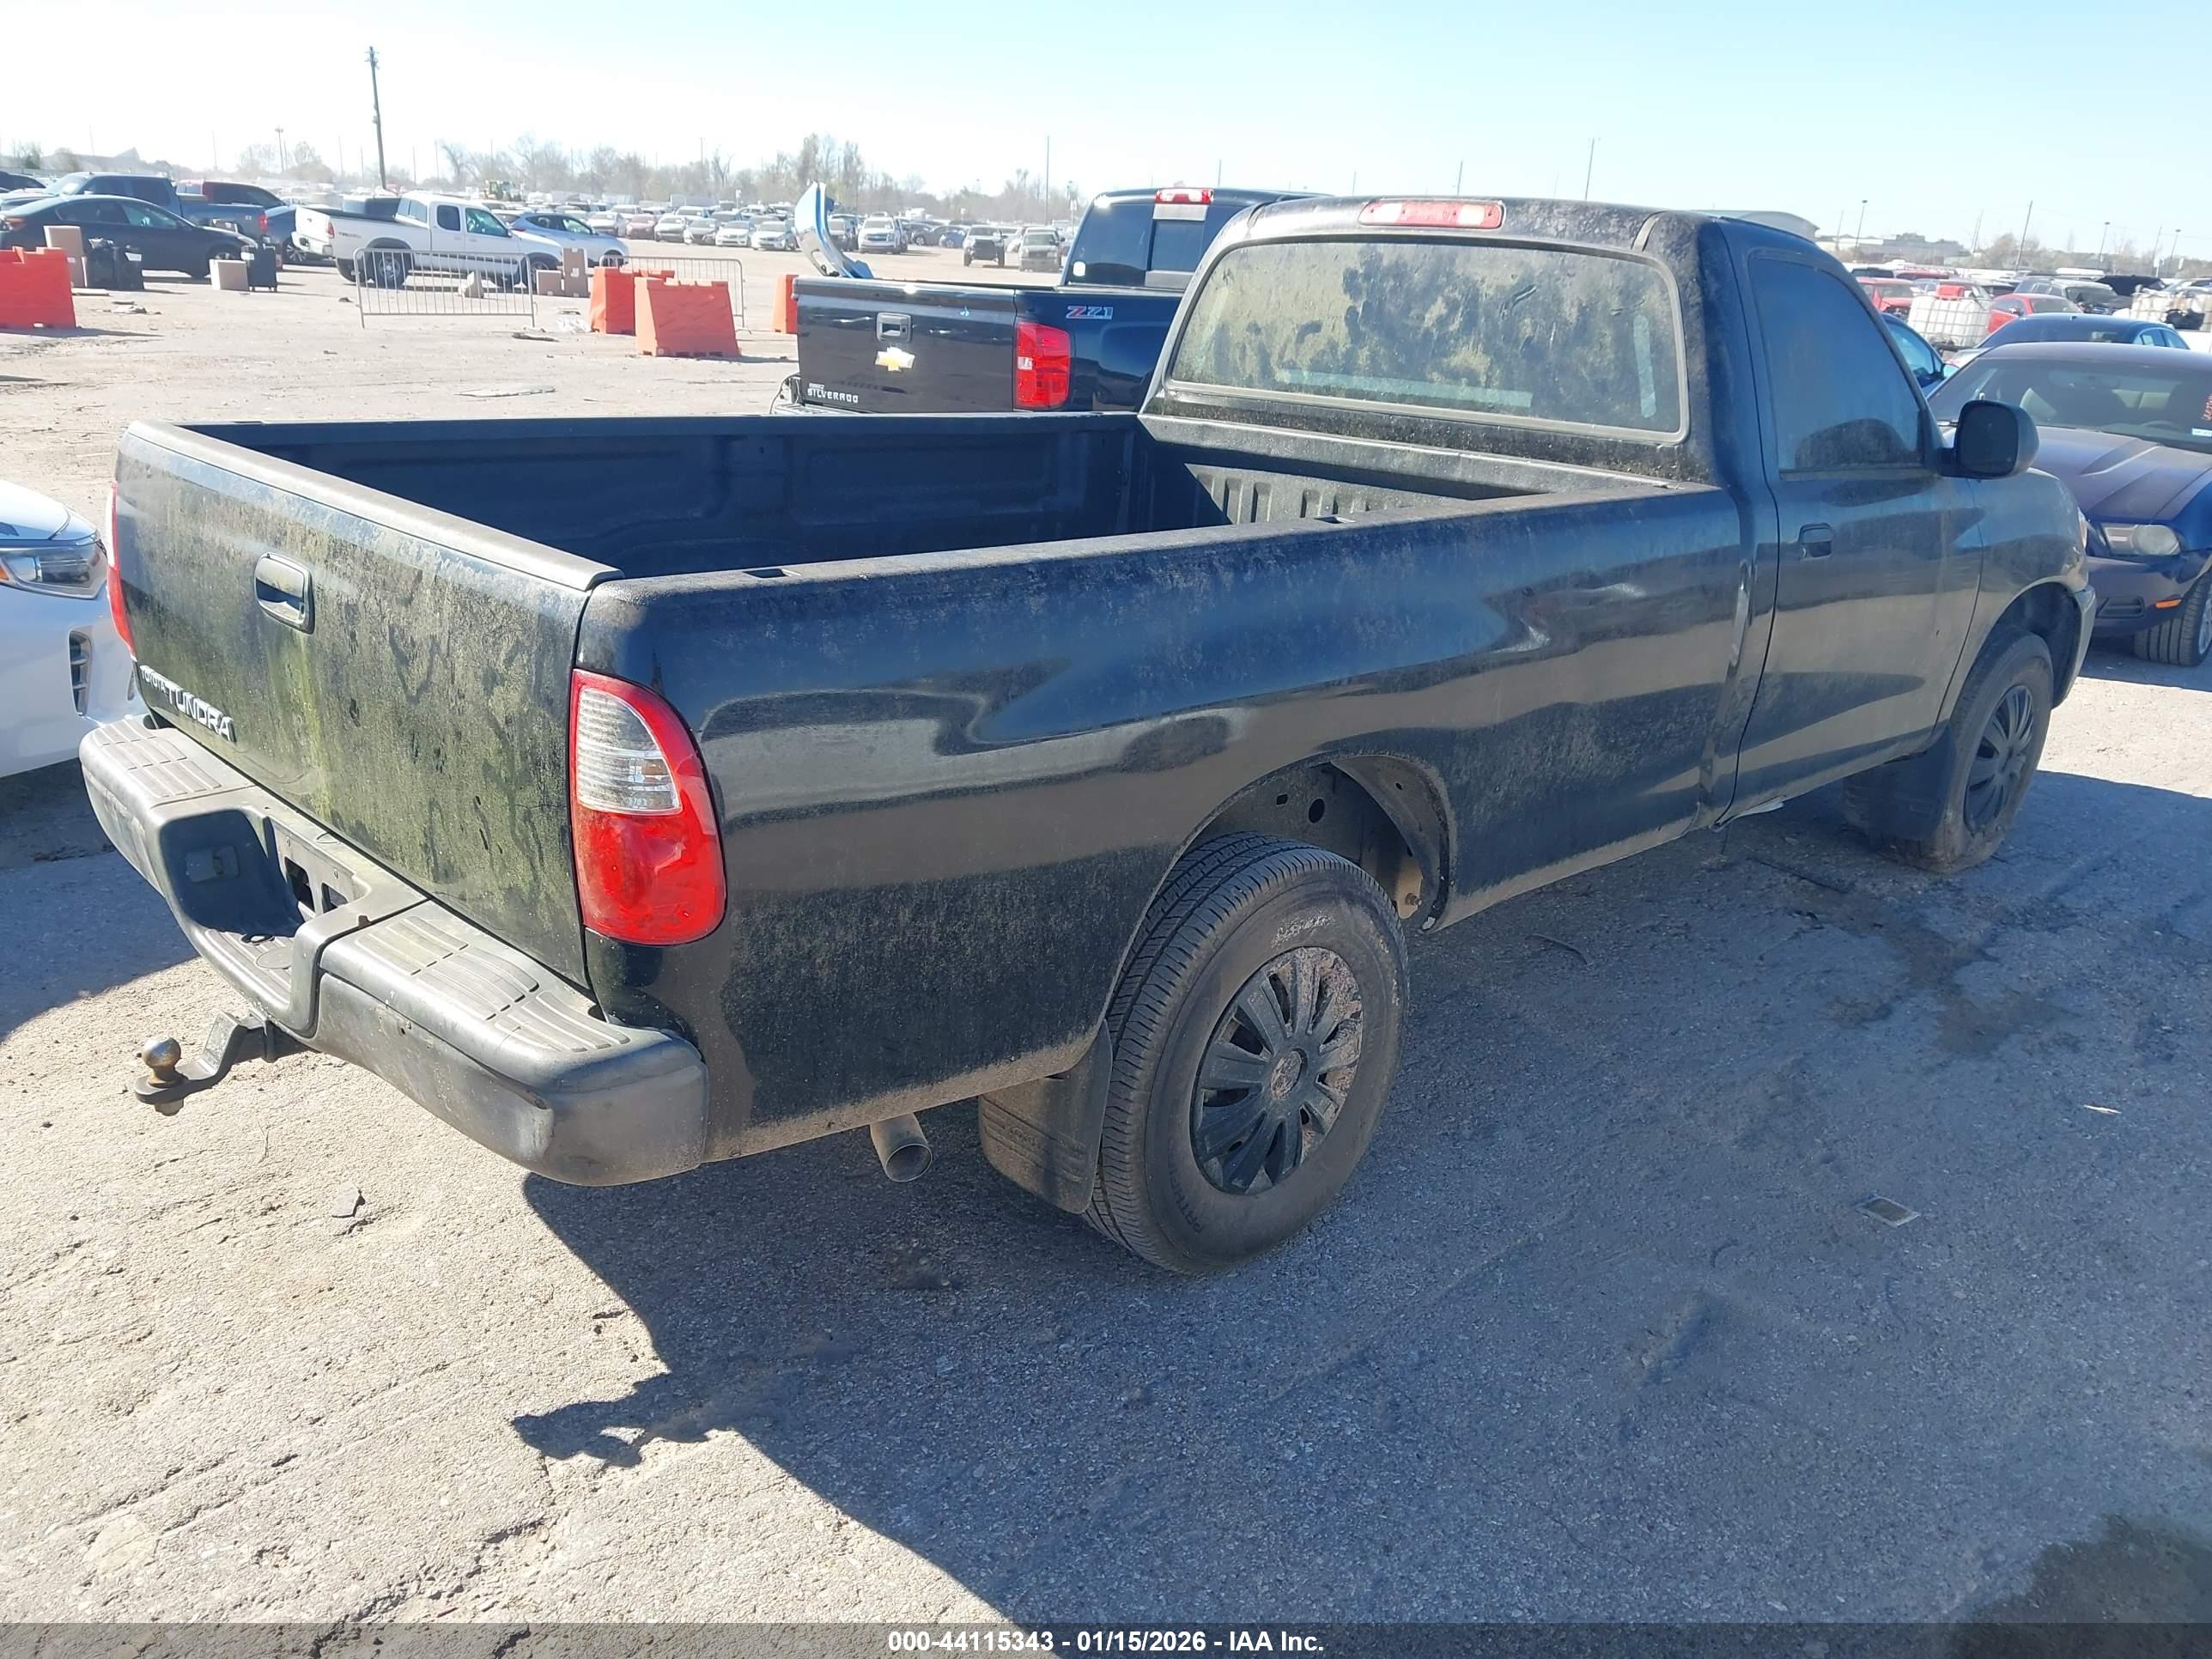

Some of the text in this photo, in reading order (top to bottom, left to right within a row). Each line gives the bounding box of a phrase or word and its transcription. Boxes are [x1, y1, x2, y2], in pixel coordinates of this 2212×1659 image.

[1066, 306, 1114, 319] Z71
[807, 388, 859, 404] SILVERADO
[167, 684, 235, 742] TUNDRA
